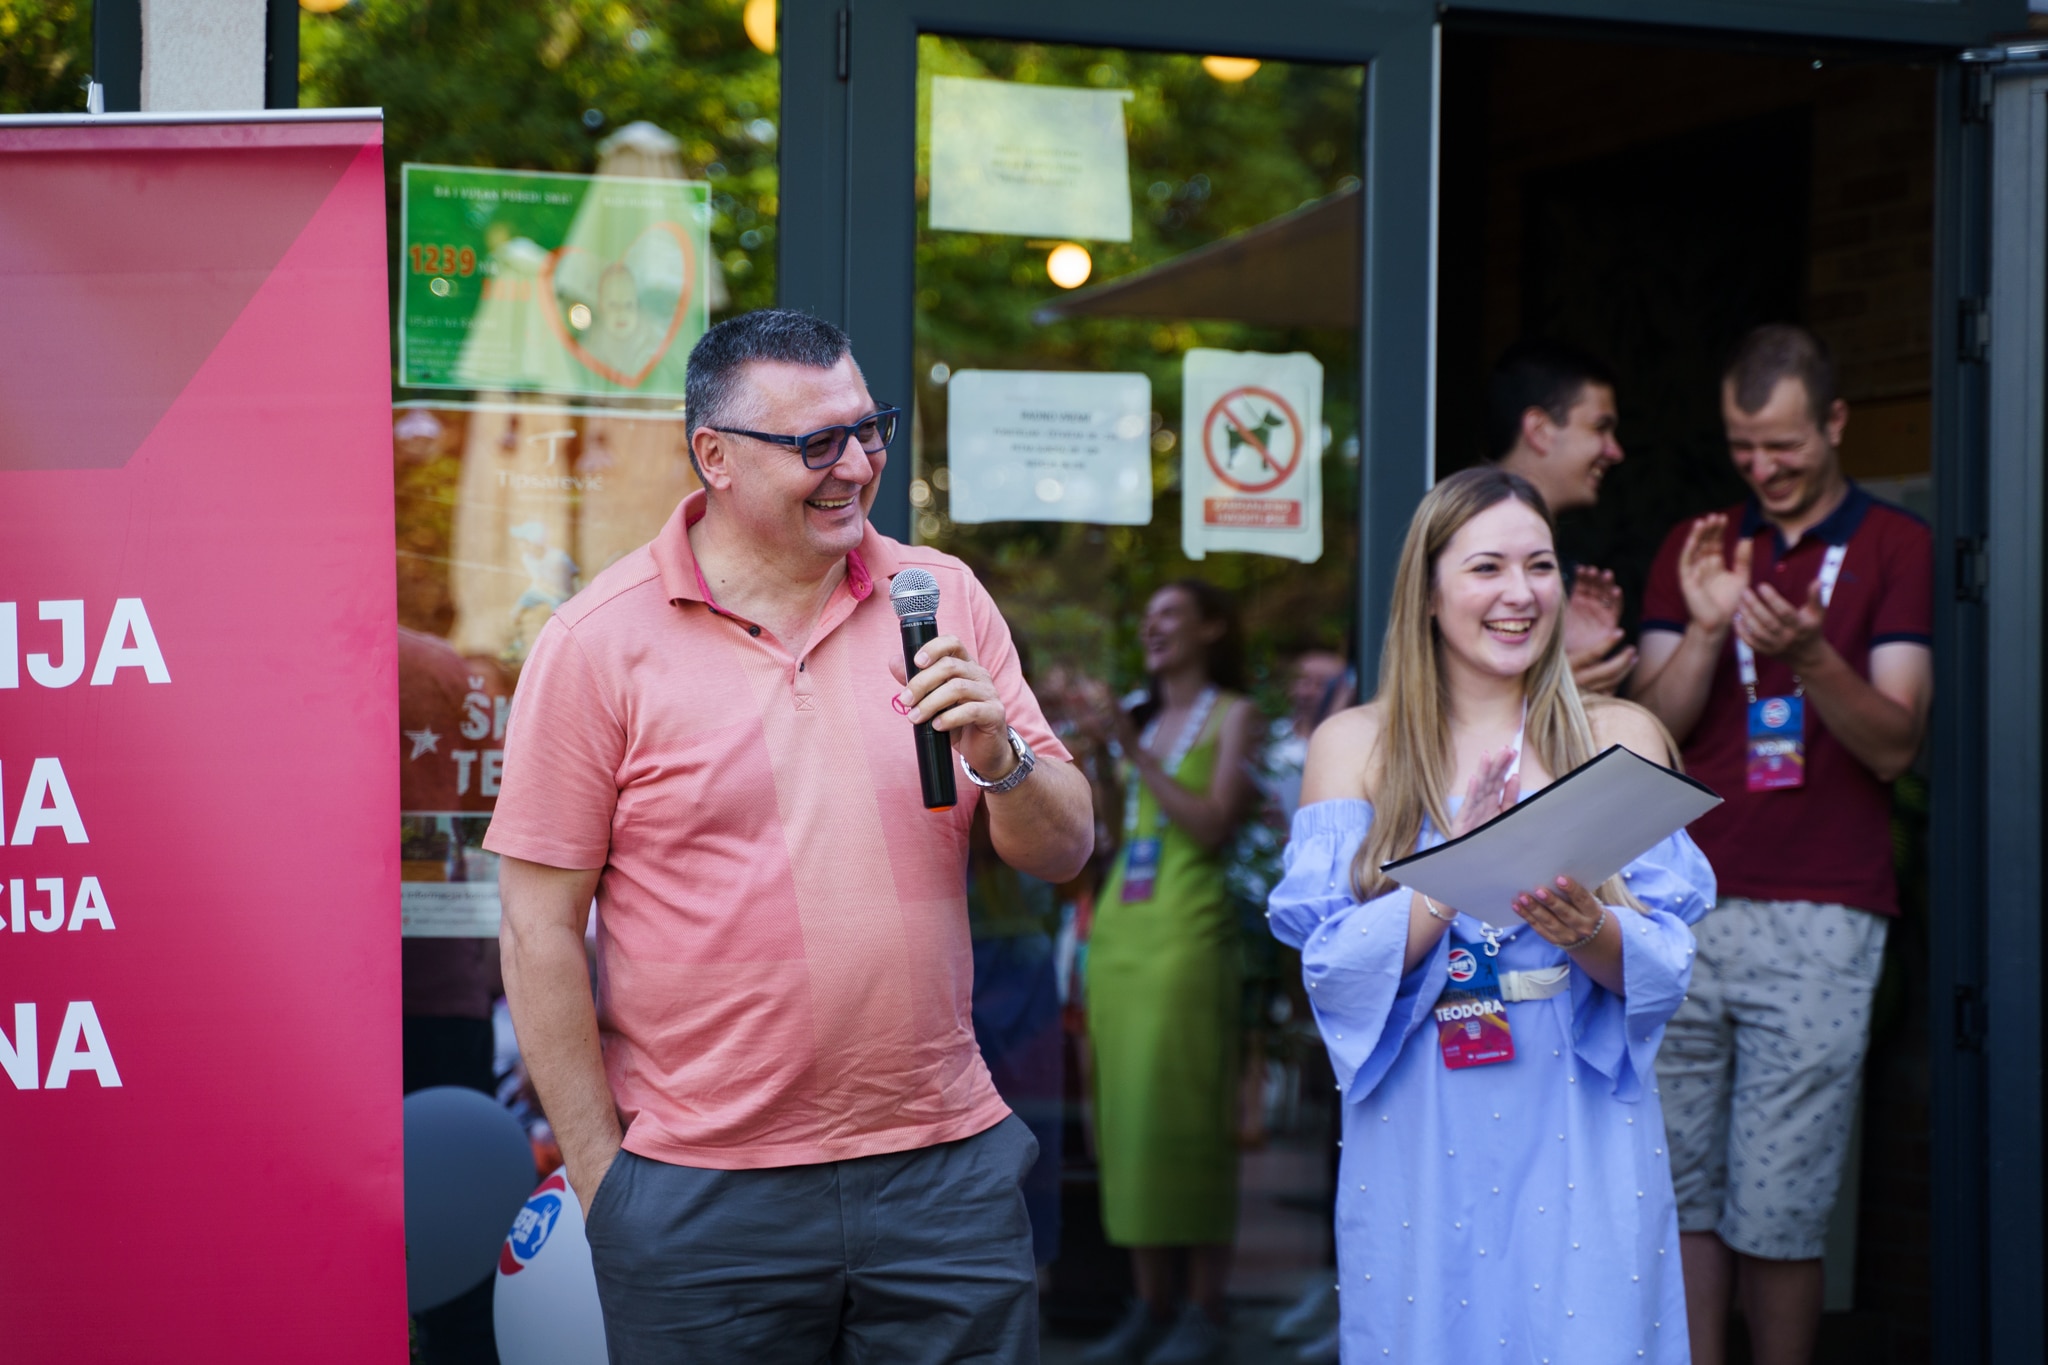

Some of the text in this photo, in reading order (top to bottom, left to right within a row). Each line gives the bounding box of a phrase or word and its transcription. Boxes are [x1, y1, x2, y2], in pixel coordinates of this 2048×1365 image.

[410, 244, 476, 277] 1239
[0, 757, 90, 846] A
[0, 876, 116, 933] IJA
[1436, 999, 1505, 1022] TEODORA
